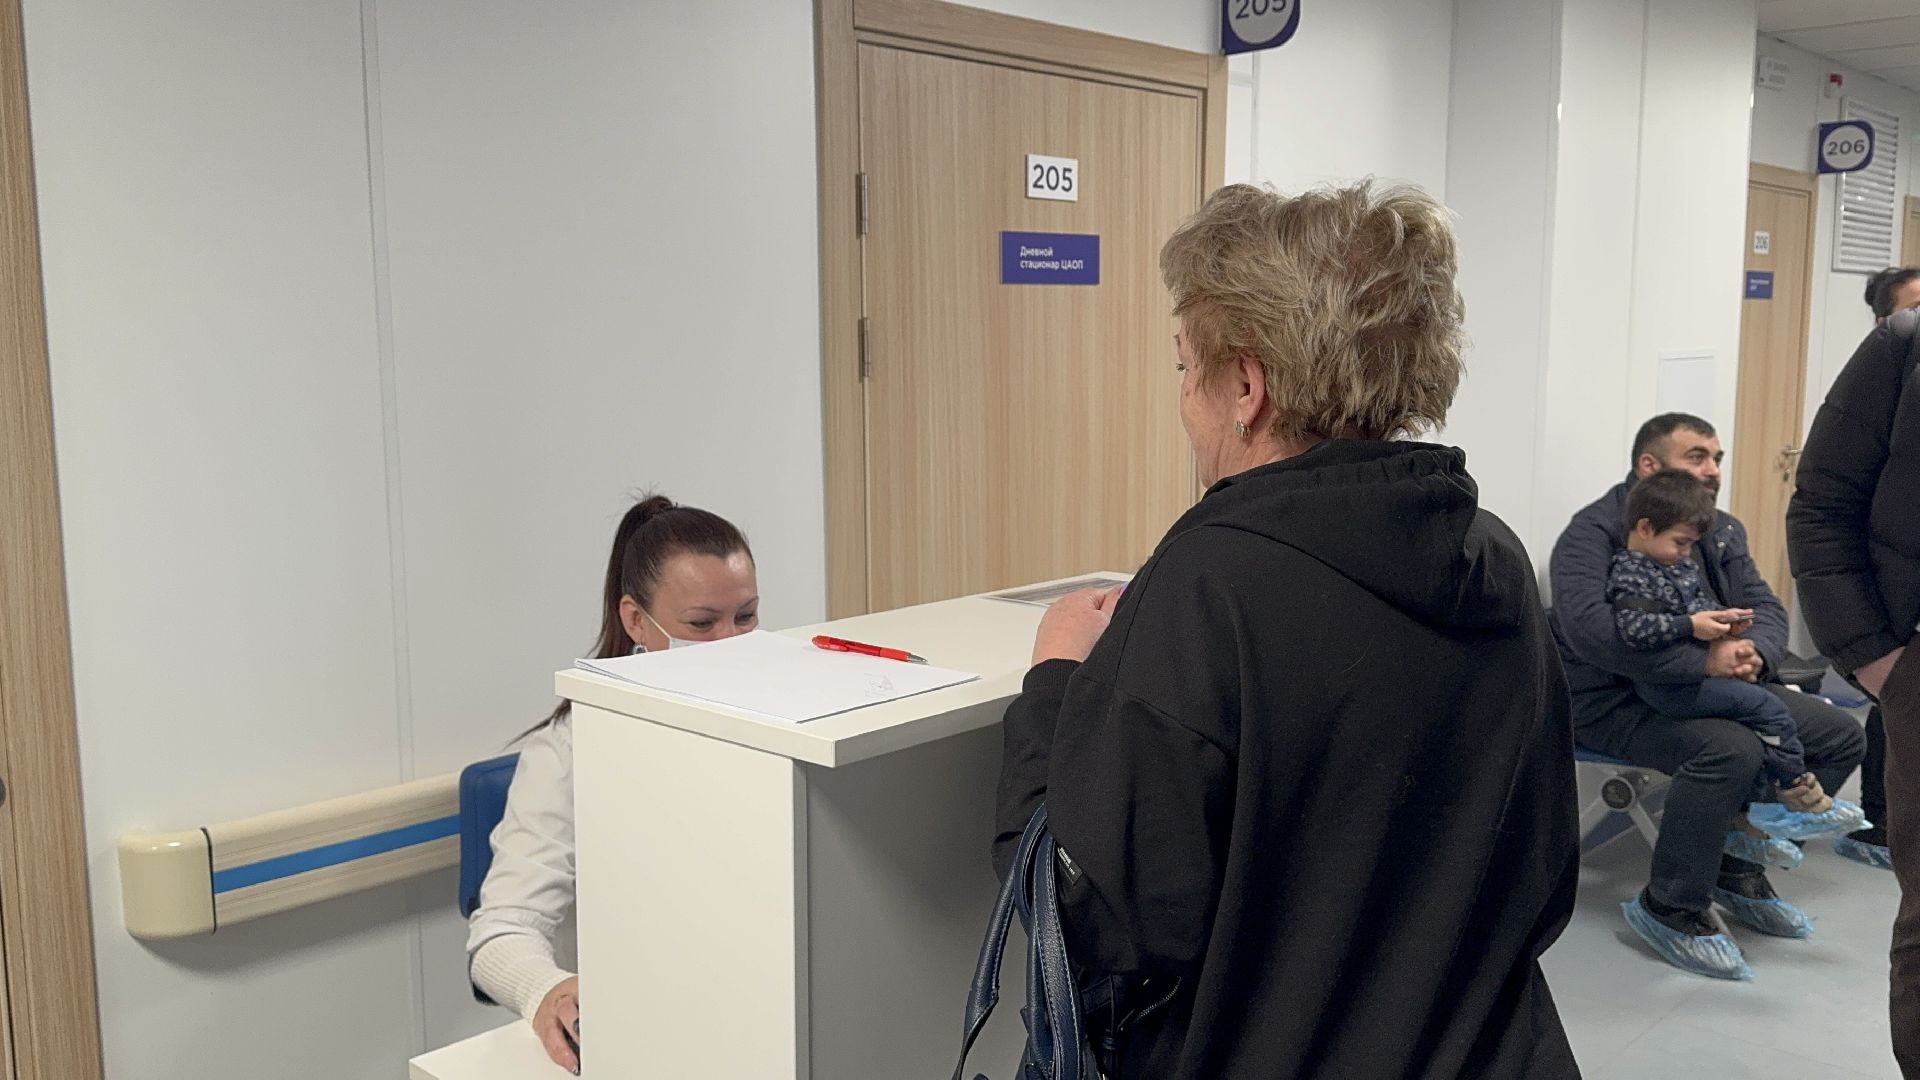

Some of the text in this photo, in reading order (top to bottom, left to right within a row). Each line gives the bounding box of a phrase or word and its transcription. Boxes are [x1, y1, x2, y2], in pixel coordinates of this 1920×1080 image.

[1235, 0, 1287, 19] 205
[1826, 140, 1865, 156] 206
[1032, 163, 1073, 192] 205
[1020, 246, 1053, 257] Дневной
[1020, 260, 1083, 270] стационар ЦАОП
